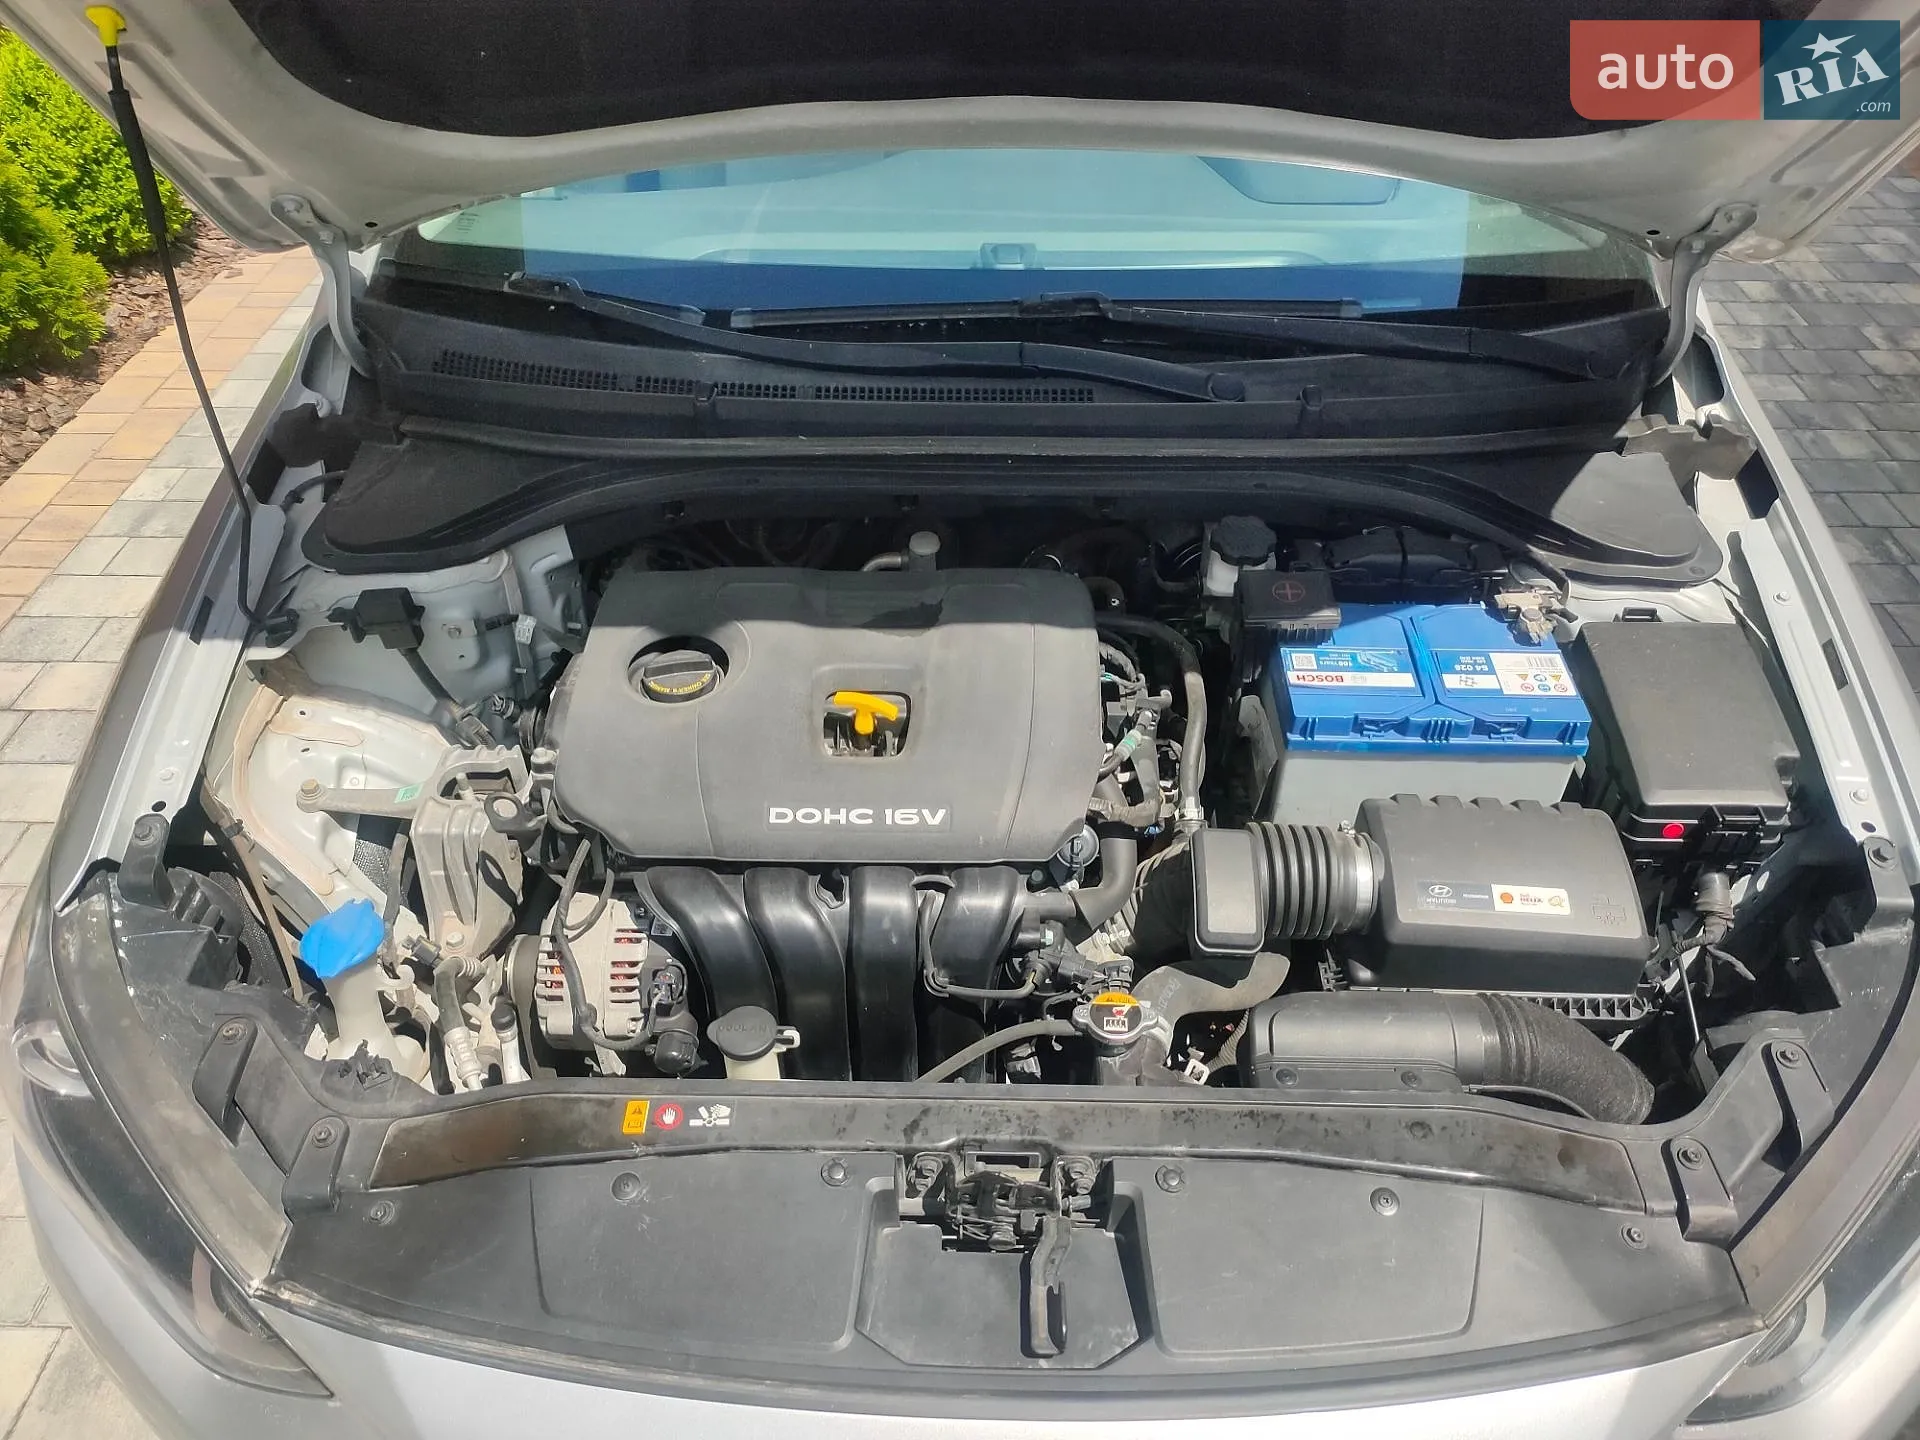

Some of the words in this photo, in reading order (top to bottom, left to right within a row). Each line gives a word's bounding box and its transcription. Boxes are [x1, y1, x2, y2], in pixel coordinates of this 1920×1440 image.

[1296, 675, 1344, 683] BOSCH
[768, 807, 873, 825] DOHC
[884, 808, 946, 825] 16V
